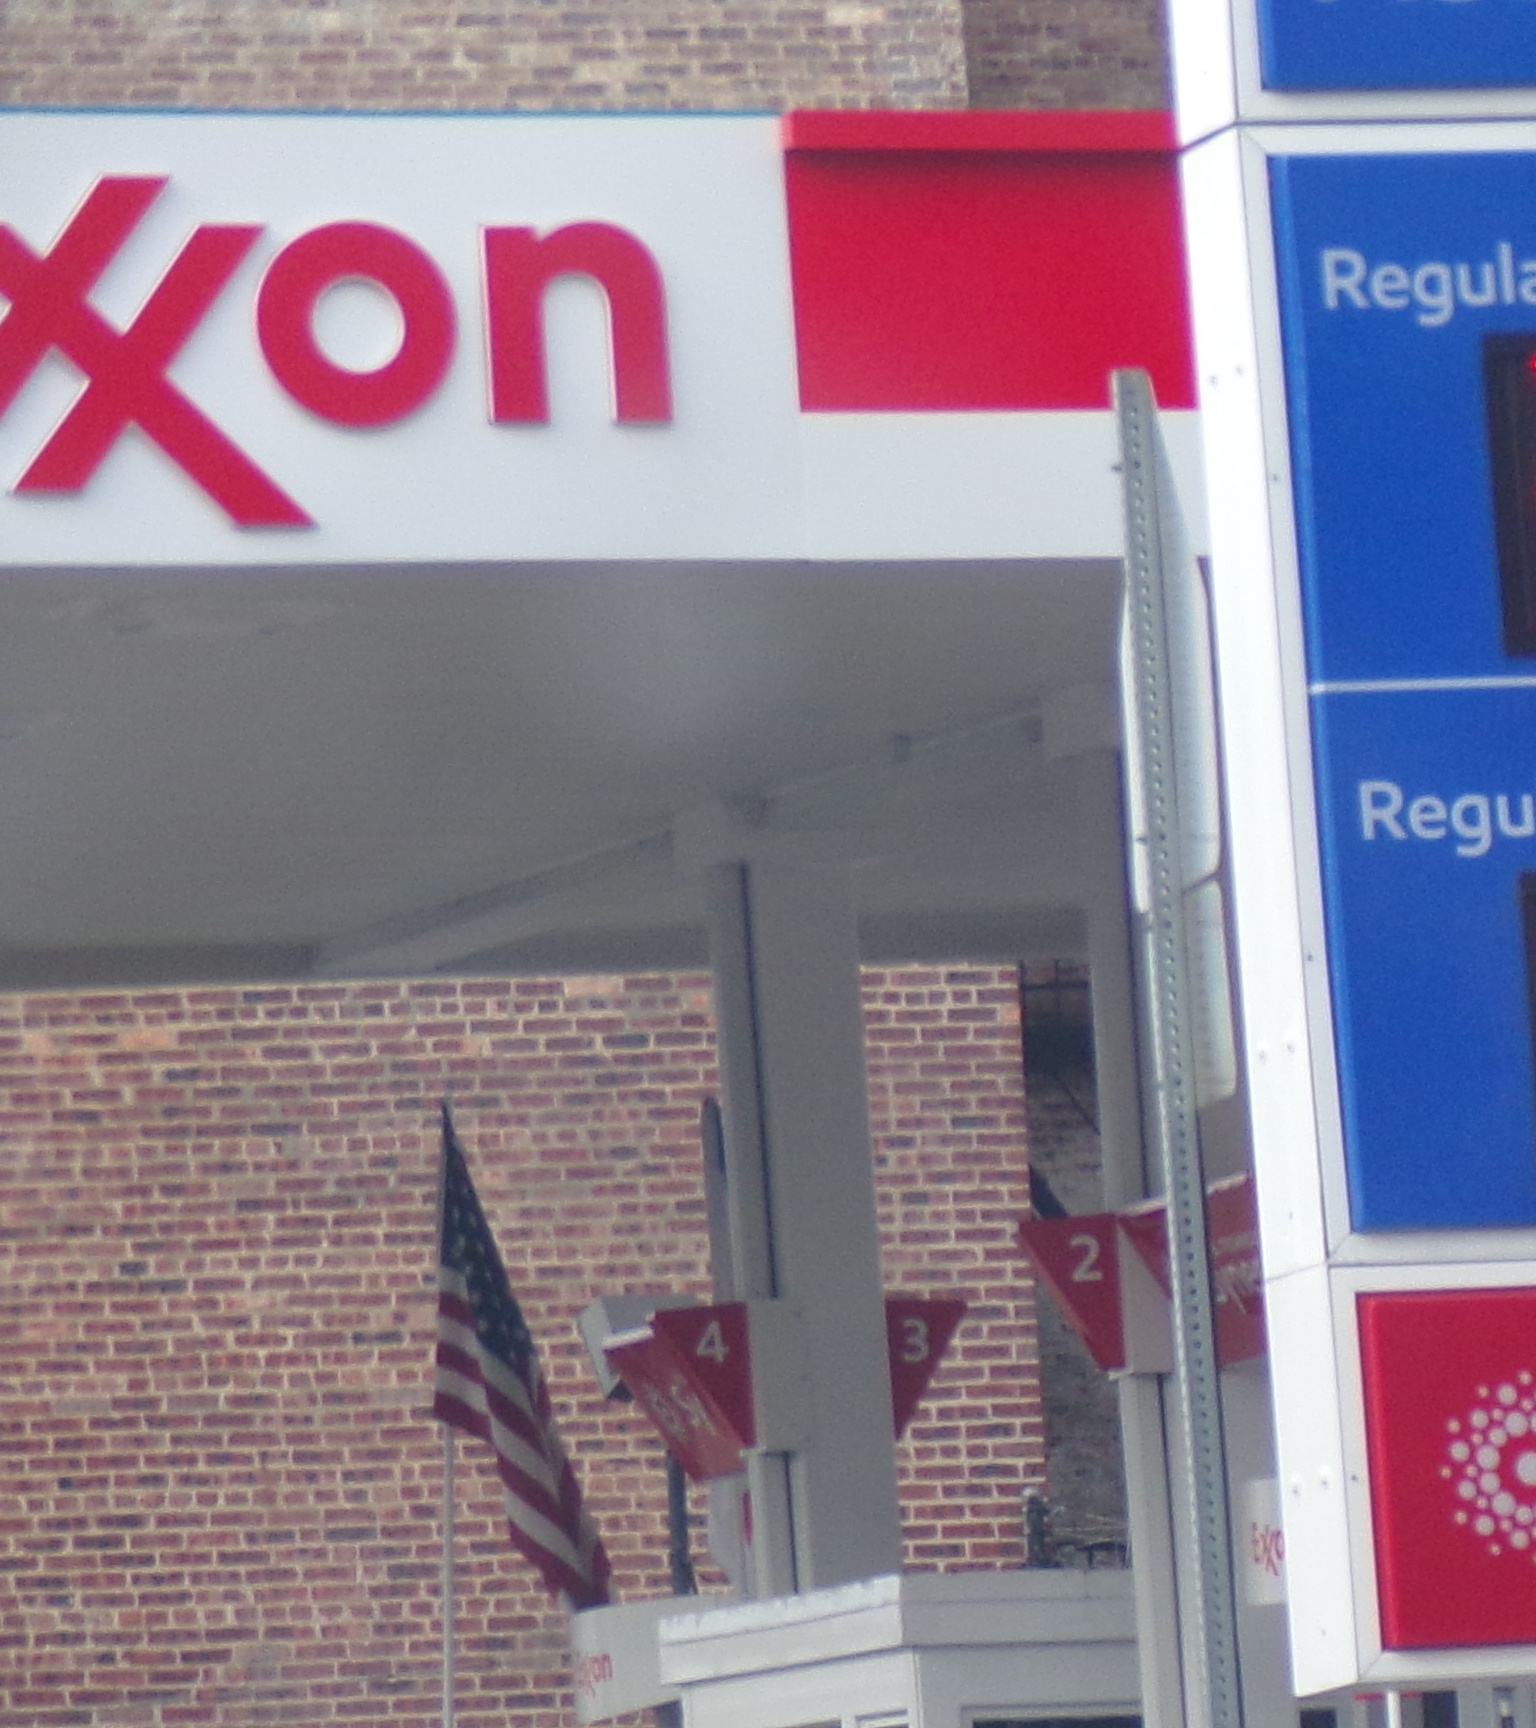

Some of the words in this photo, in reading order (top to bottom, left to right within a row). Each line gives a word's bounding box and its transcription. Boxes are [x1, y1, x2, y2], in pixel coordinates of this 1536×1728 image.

[1070, 1235, 1104, 1282] 2
[698, 1319, 730, 1363] 4
[902, 1317, 929, 1364] 3
